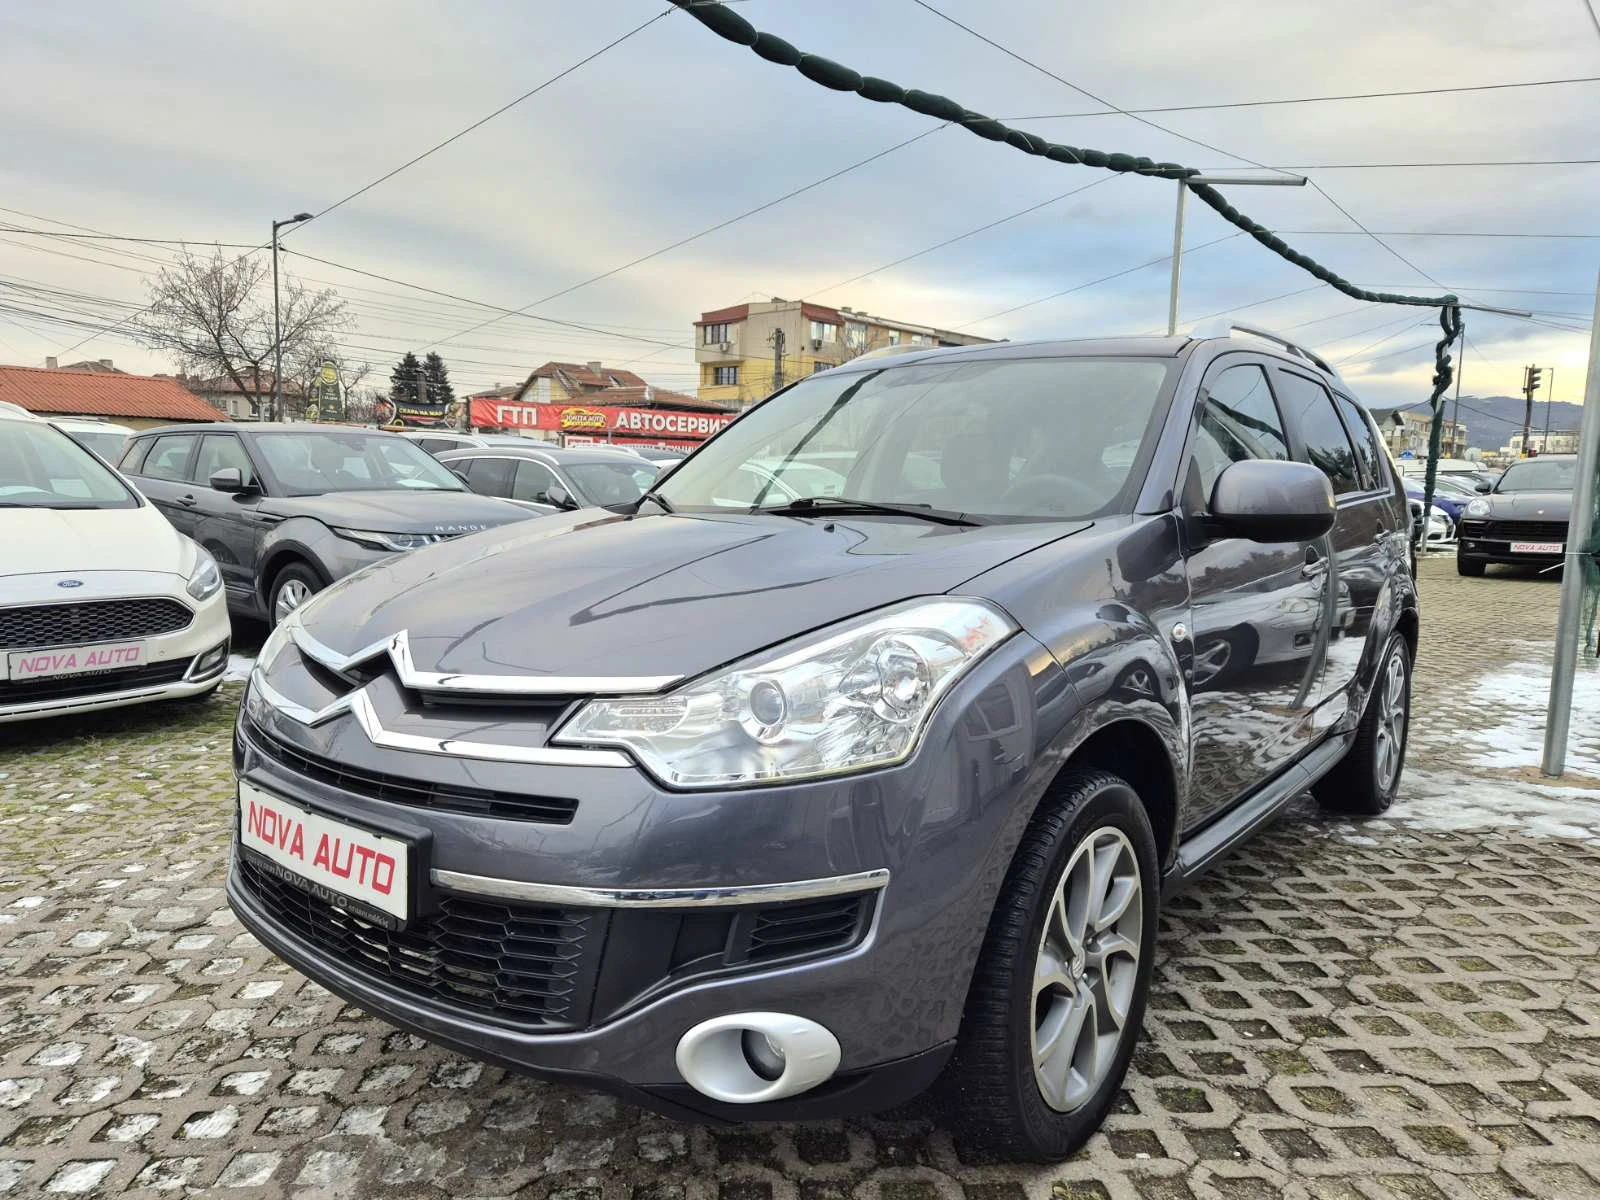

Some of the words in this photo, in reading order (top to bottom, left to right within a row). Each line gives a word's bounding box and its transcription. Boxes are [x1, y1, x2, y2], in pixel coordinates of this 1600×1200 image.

[497, 405, 537, 425] ГТП
[18, 653, 78, 673] NOVA
[84, 647, 141, 666] AUTO
[53, 672, 82, 680] NOVA
[248, 801, 304, 861] NOVA
[313, 833, 396, 895] AUTO
[275, 864, 310, 891] NOVA
[311, 884, 348, 908] AUTO
